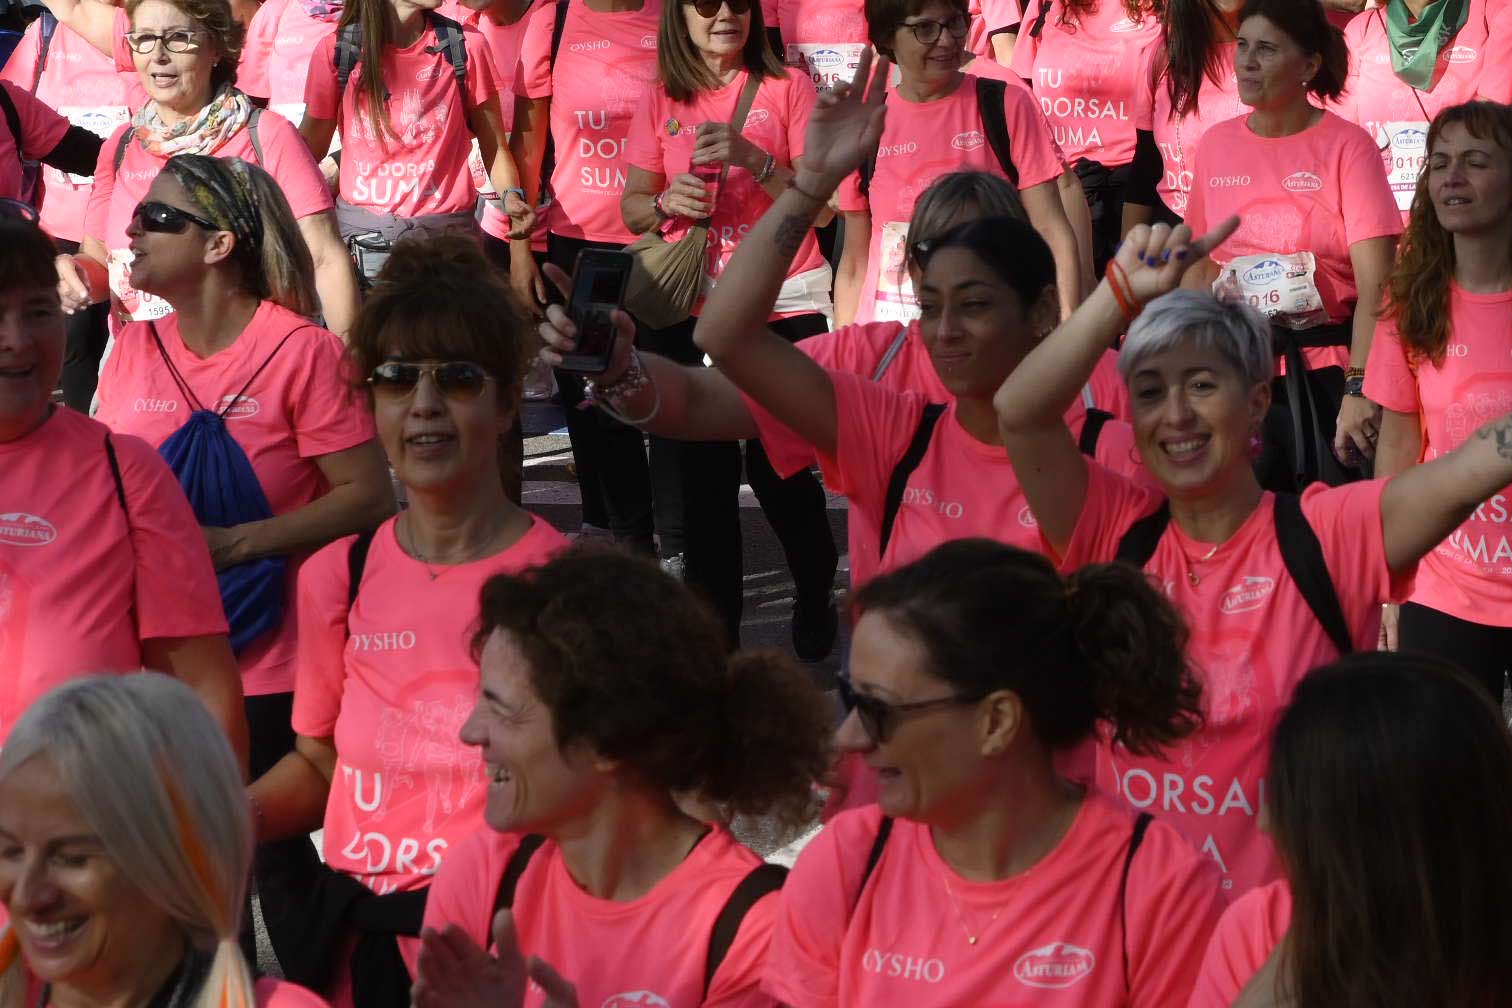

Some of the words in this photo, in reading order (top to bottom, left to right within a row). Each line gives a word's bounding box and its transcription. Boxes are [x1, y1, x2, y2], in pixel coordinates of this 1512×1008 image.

[813, 72, 840, 83] 016
[1038, 68, 1062, 88] TU
[1041, 97, 1128, 120] DORSAL
[574, 111, 606, 129] TU
[1209, 175, 1251, 188] OYSHO
[1112, 761, 1265, 816] ORSA
